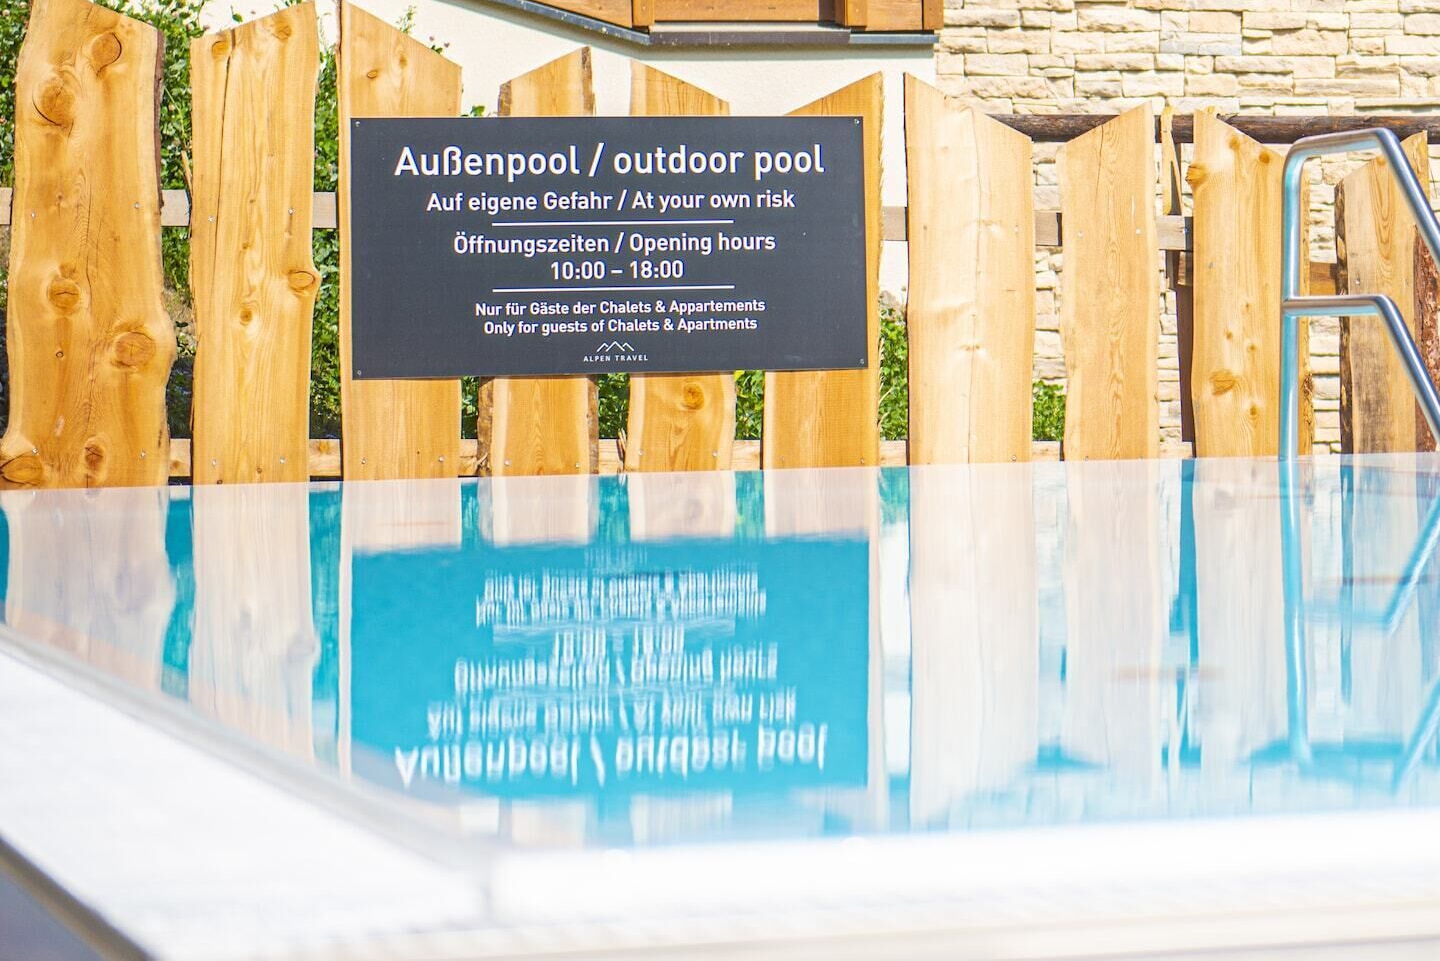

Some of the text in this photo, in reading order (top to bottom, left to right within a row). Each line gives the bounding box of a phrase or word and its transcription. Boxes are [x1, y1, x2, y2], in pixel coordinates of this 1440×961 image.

[394, 142, 825, 183] Außenpool / outdoor pool
[426, 189, 796, 216] Auf eigene Gefahr / At your own risk
[454, 231, 776, 258] Öffnungszeiten / Opening hours
[550, 260, 605, 280] 10:00
[629, 259, 684, 279] 18:00
[475, 299, 766, 317] Nur für Gäste der Chalets & Appartements
[484, 317, 758, 337] Only for guests of Chalets & Apartments
[583, 354, 649, 363] ALPEN TRAVEL
